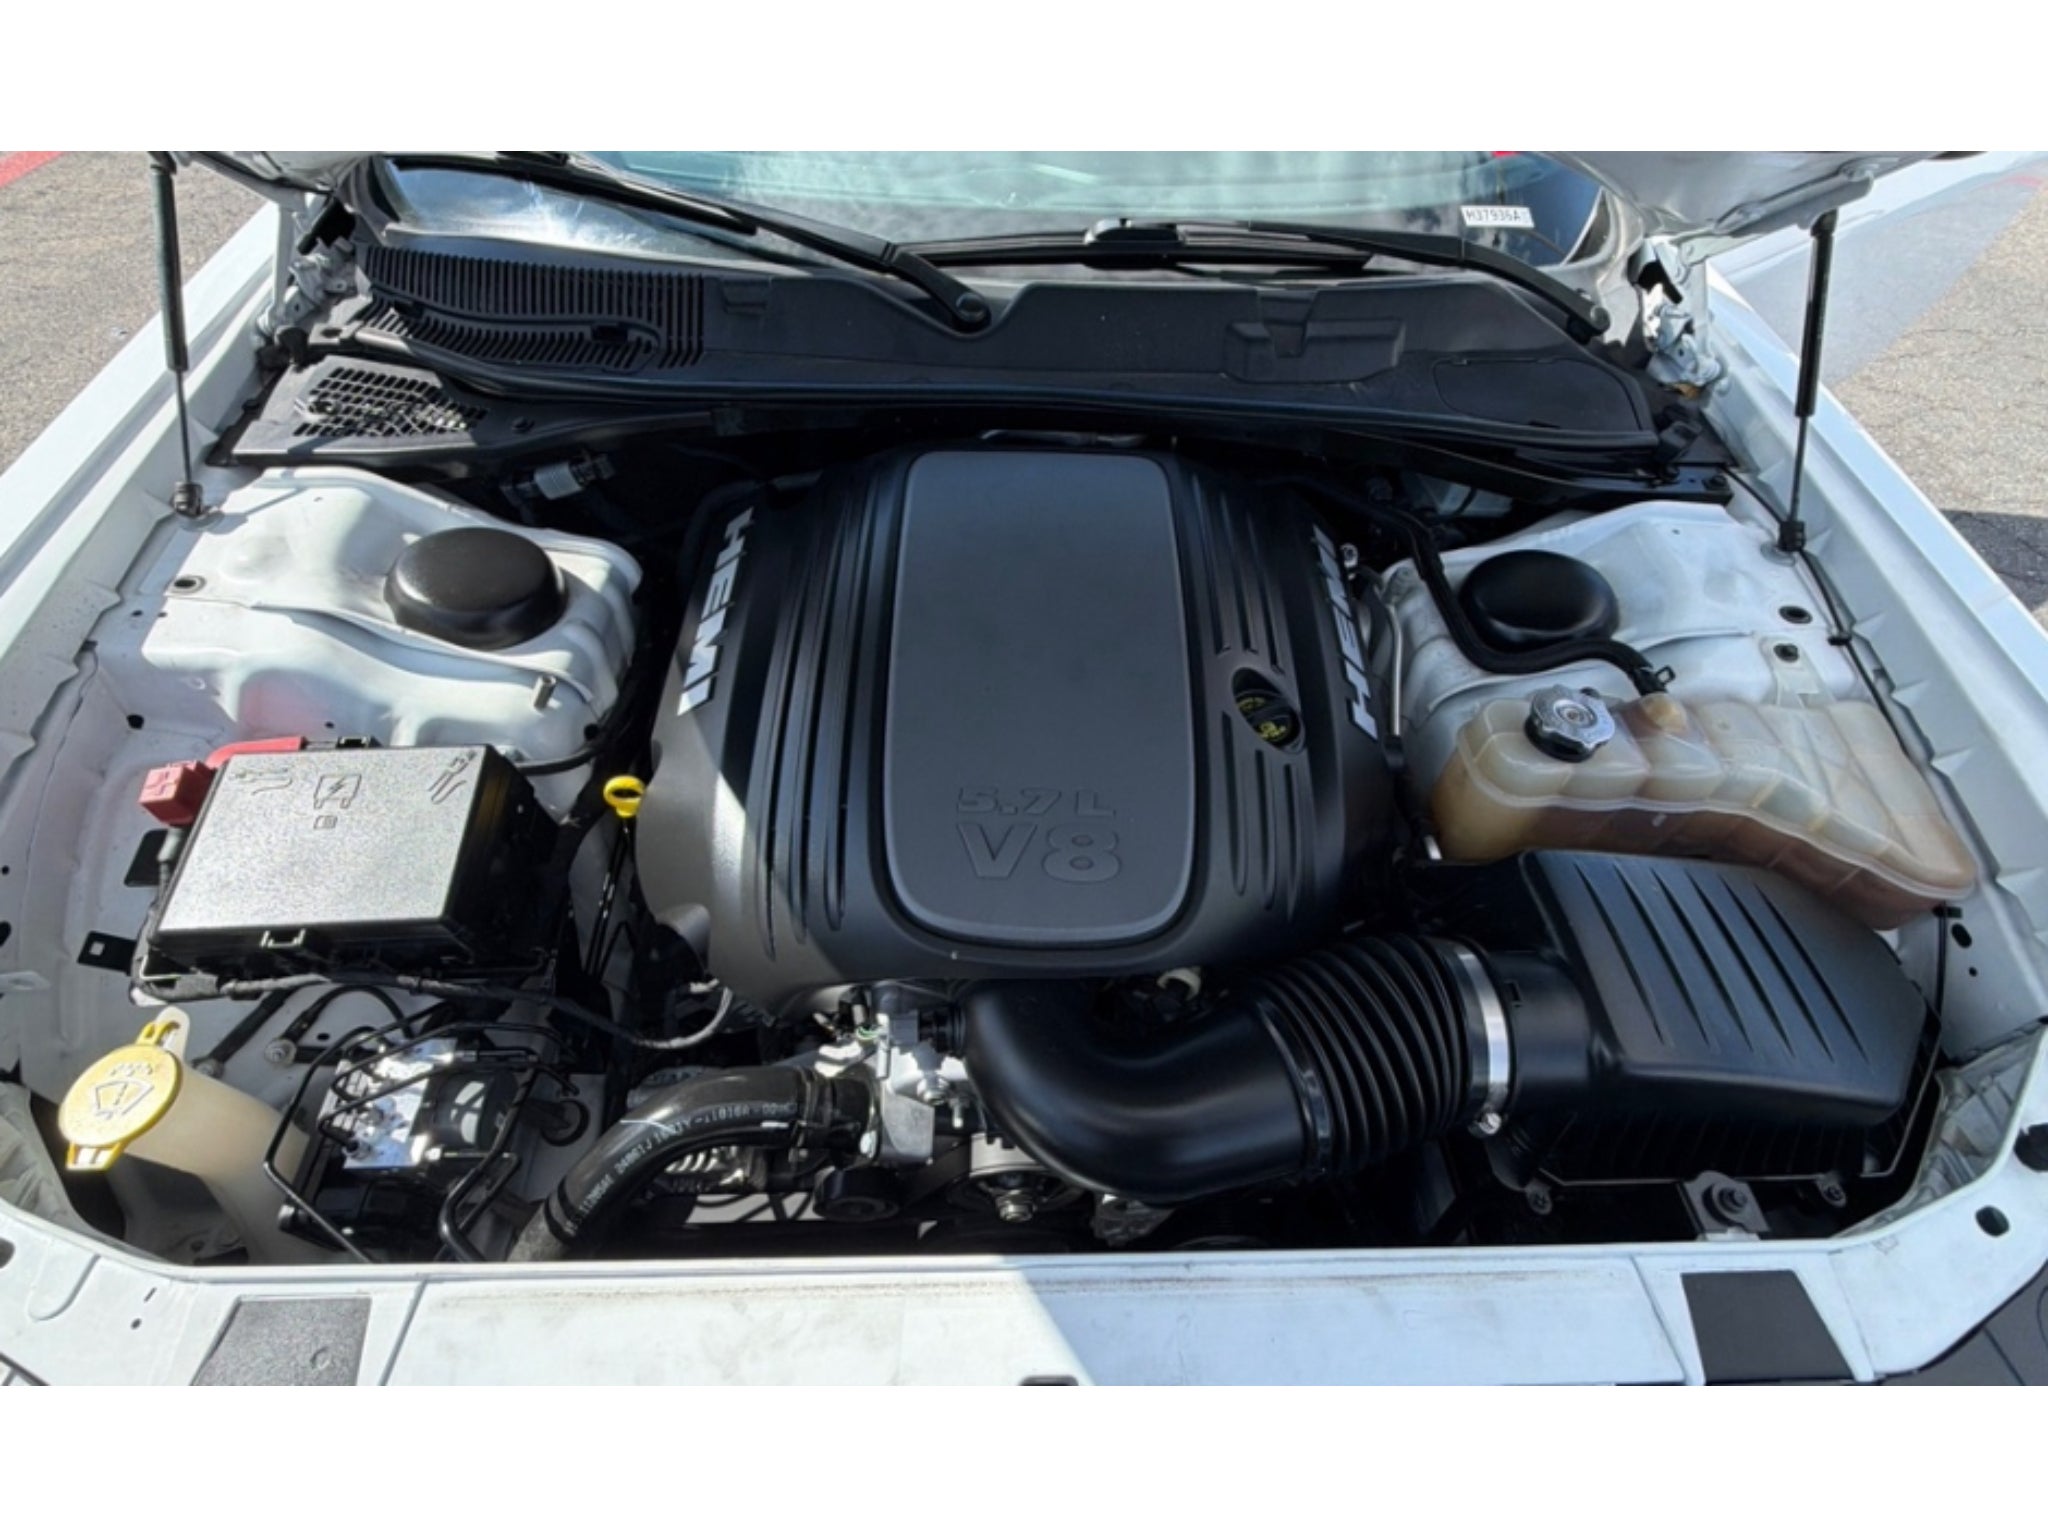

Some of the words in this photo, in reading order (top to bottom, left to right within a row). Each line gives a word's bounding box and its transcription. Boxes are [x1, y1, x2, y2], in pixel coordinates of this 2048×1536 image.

[677, 505, 755, 716] HEMI
[1312, 523, 1379, 741] HEMI
[955, 822, 1123, 885] V8
